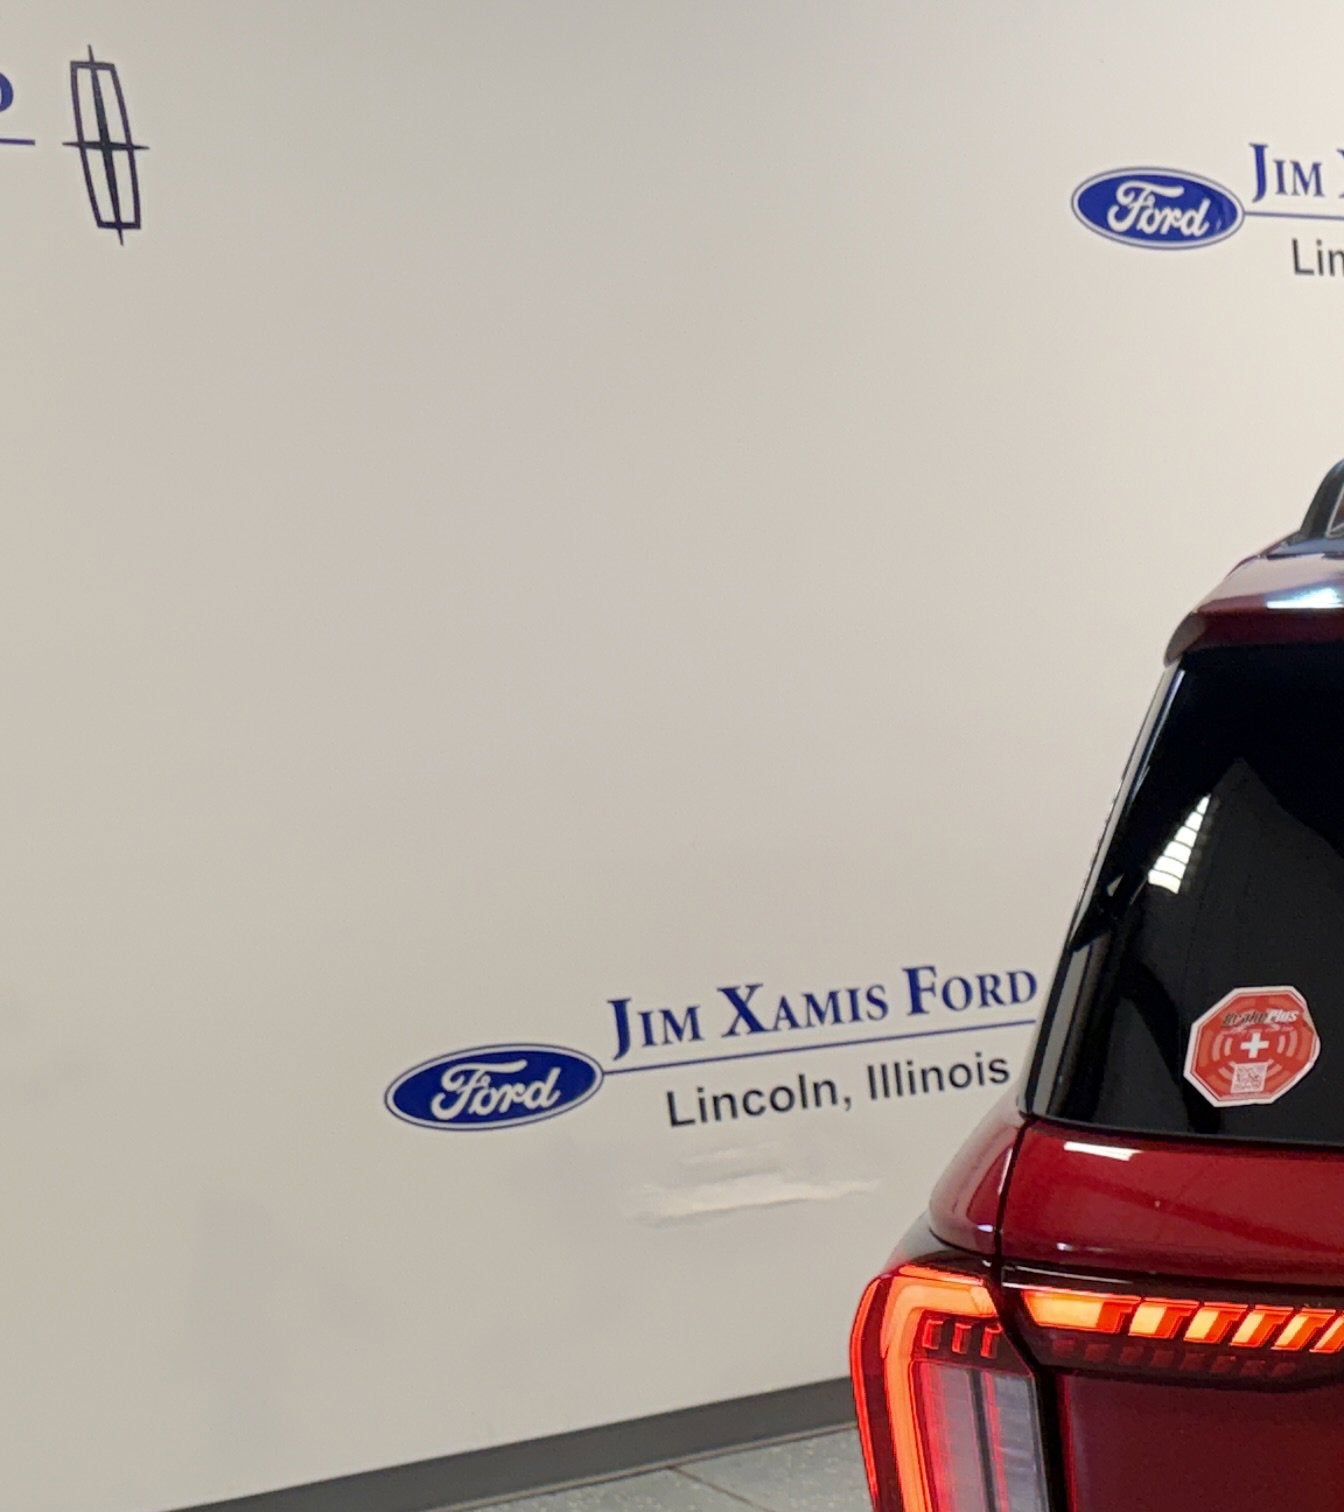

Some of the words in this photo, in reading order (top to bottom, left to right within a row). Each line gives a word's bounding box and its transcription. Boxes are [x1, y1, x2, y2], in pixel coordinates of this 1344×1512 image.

[1249, 143, 1324, 202] JIM
[1106, 180, 1210, 239] Ford
[607, 997, 703, 1061] JIM
[717, 983, 890, 1038] XAMIS
[902, 966, 1038, 1016] FORD
[430, 1060, 562, 1120] Ford
[667, 1073, 852, 1128] Lincoln,
[867, 1051, 1010, 1101] Illinois
